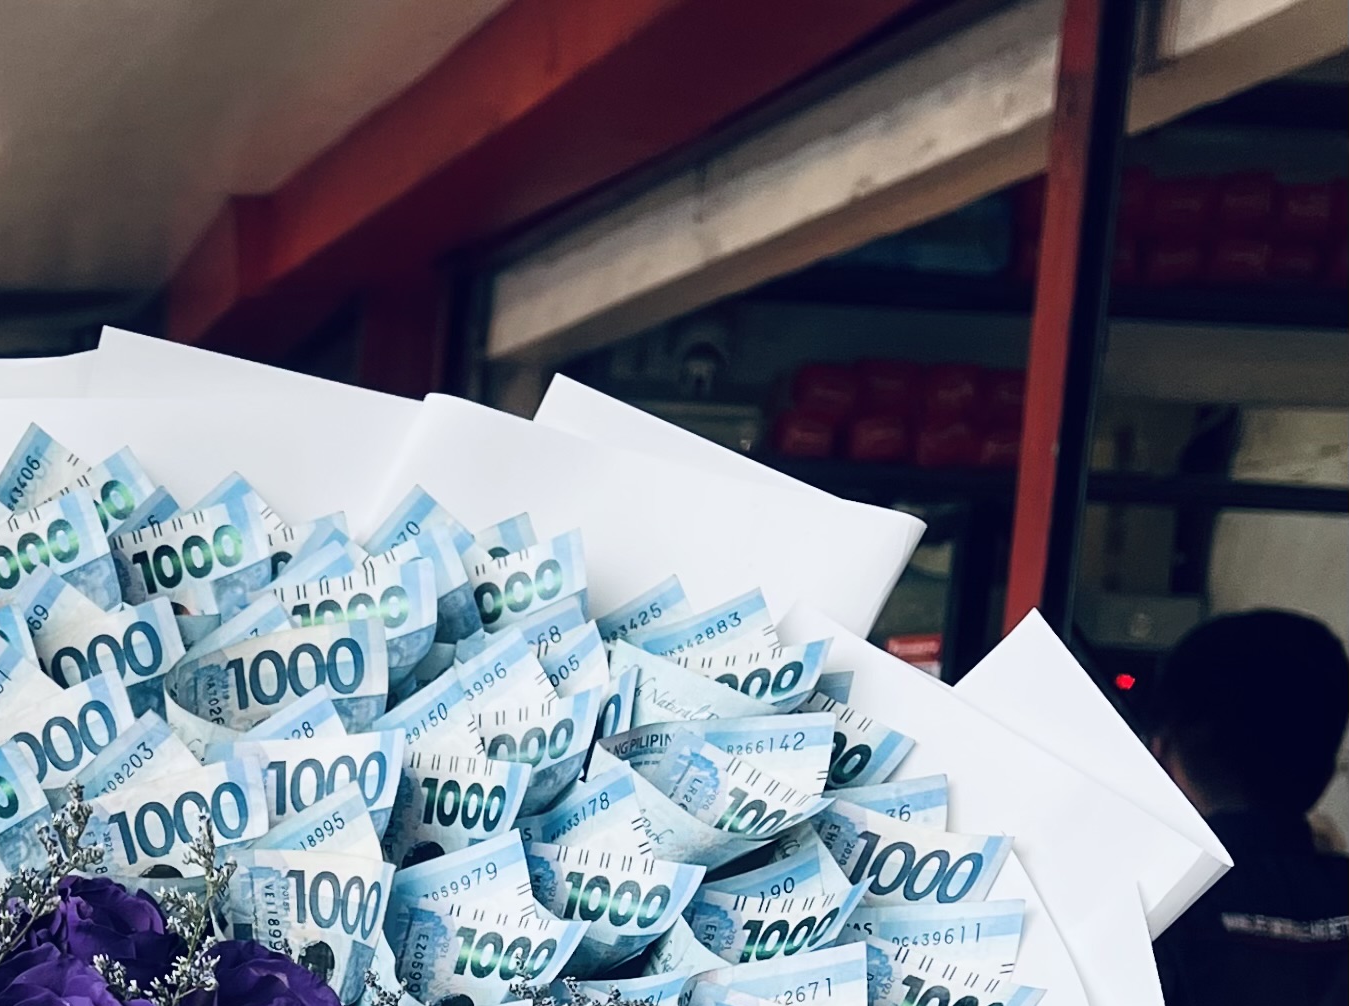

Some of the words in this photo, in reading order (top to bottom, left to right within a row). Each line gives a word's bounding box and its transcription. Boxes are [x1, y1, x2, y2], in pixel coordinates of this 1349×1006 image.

[132, 524, 244, 595] 1000
[474, 558, 563, 625] 000
[38, 621, 163, 690] 000
[225, 637, 365, 711] 1000
[99, 742, 155, 799] 08203
[478, 718, 574, 769] 000
[723, 731, 805, 756] R266142
[108, 781, 250, 866] 1000
[294, 811, 346, 852] 18995
[421, 777, 506, 833] 1000
[423, 861, 498, 902] 059979
[852, 831, 984, 904] 1000
[288, 868, 382, 941] 1000
[563, 871, 672, 929] 1000
[453, 926, 558, 982] 1000
[739, 907, 841, 964] 1000
